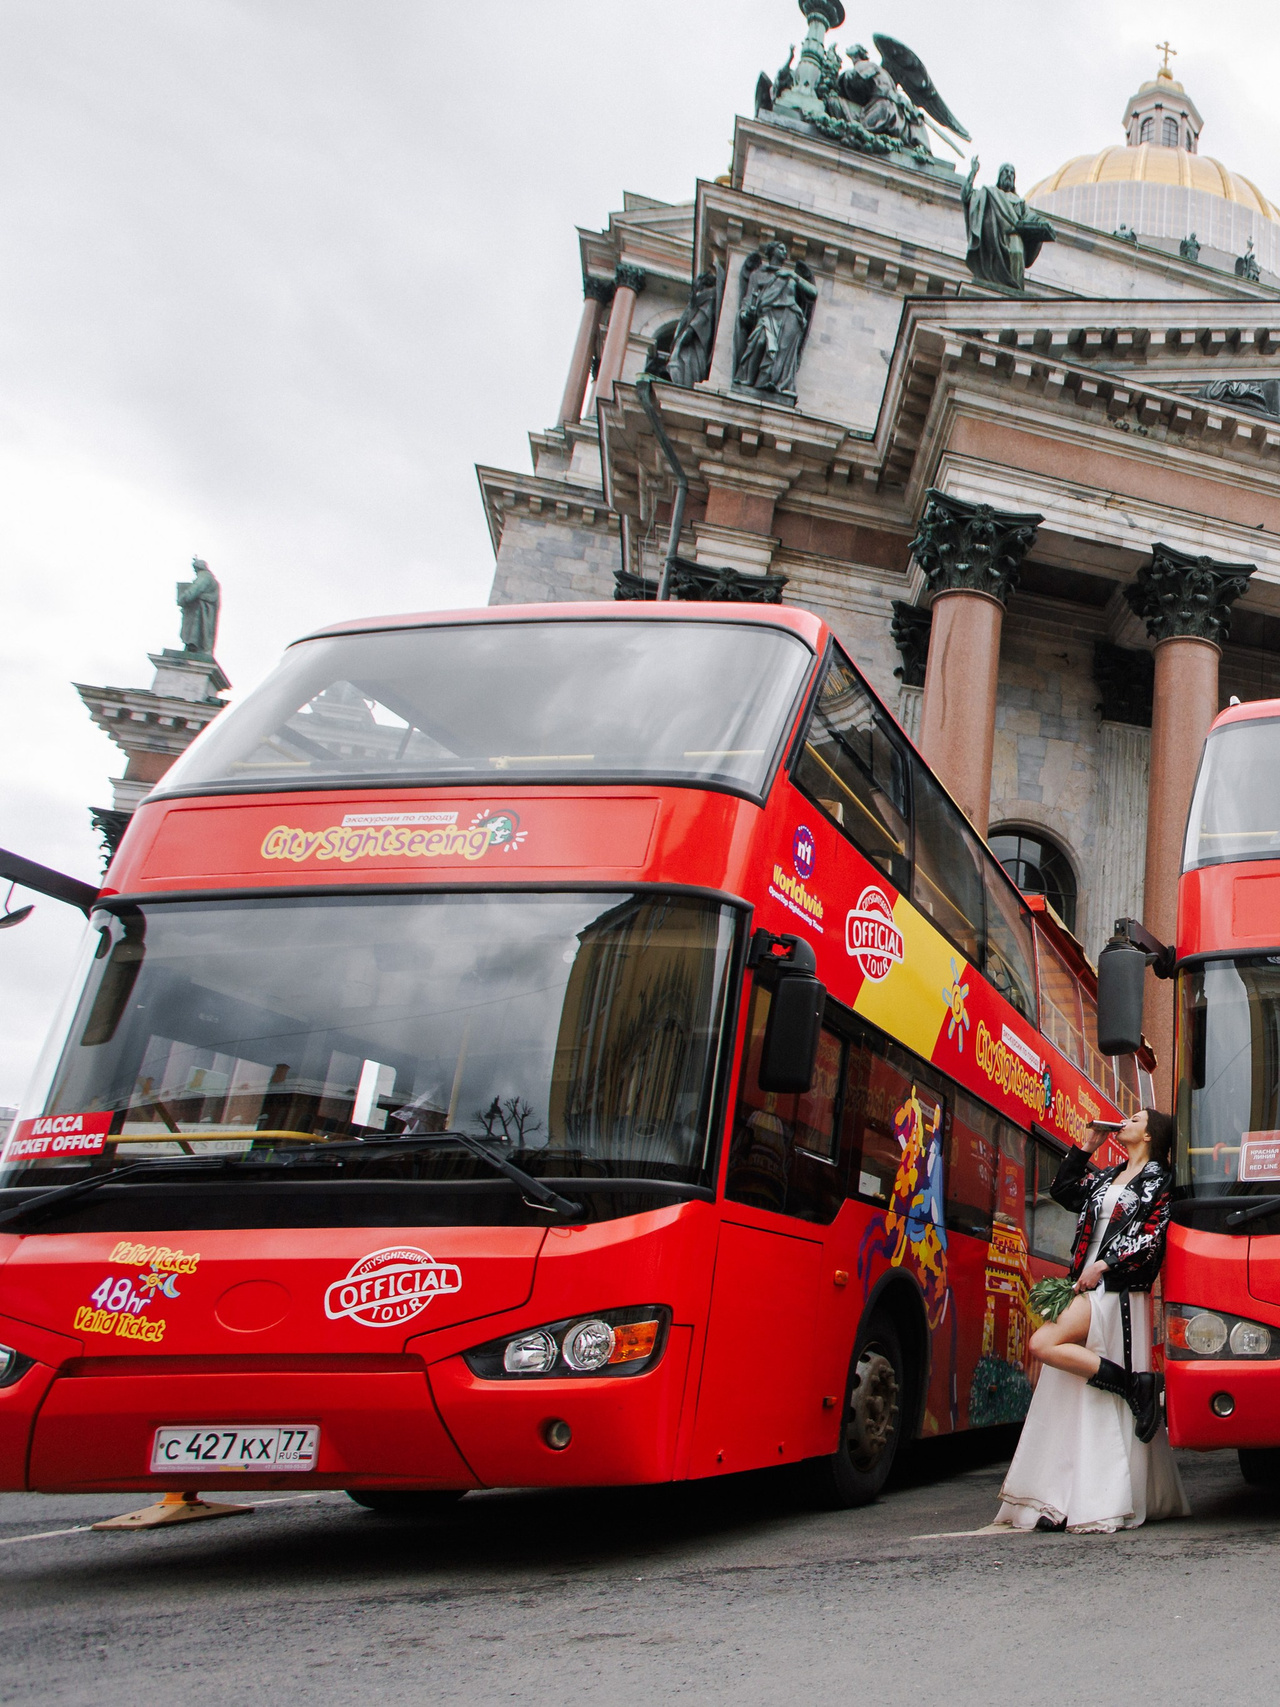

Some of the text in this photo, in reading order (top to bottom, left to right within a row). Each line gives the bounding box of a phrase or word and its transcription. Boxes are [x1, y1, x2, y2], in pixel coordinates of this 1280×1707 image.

[418, 814, 455, 823] городу
[773, 864, 823, 919] Worldwide
[853, 920, 901, 957] OFFICIAL
[866, 954, 889, 976] TOUR
[31, 1115, 84, 1136] КАССА
[9, 1133, 105, 1156] TICKET OFFICE
[108, 1241, 200, 1274] Valid Ticket
[360, 1250, 428, 1275] CITYSIGHTSEEING
[91, 1277, 151, 1313] 48hr
[340, 1269, 452, 1309] OFFICIAL
[371, 1297, 423, 1320] TOUR
[73, 1306, 166, 1342] Valid Ticket
[282, 1431, 308, 1452] 77
[278, 1452, 298, 1460] RUS
